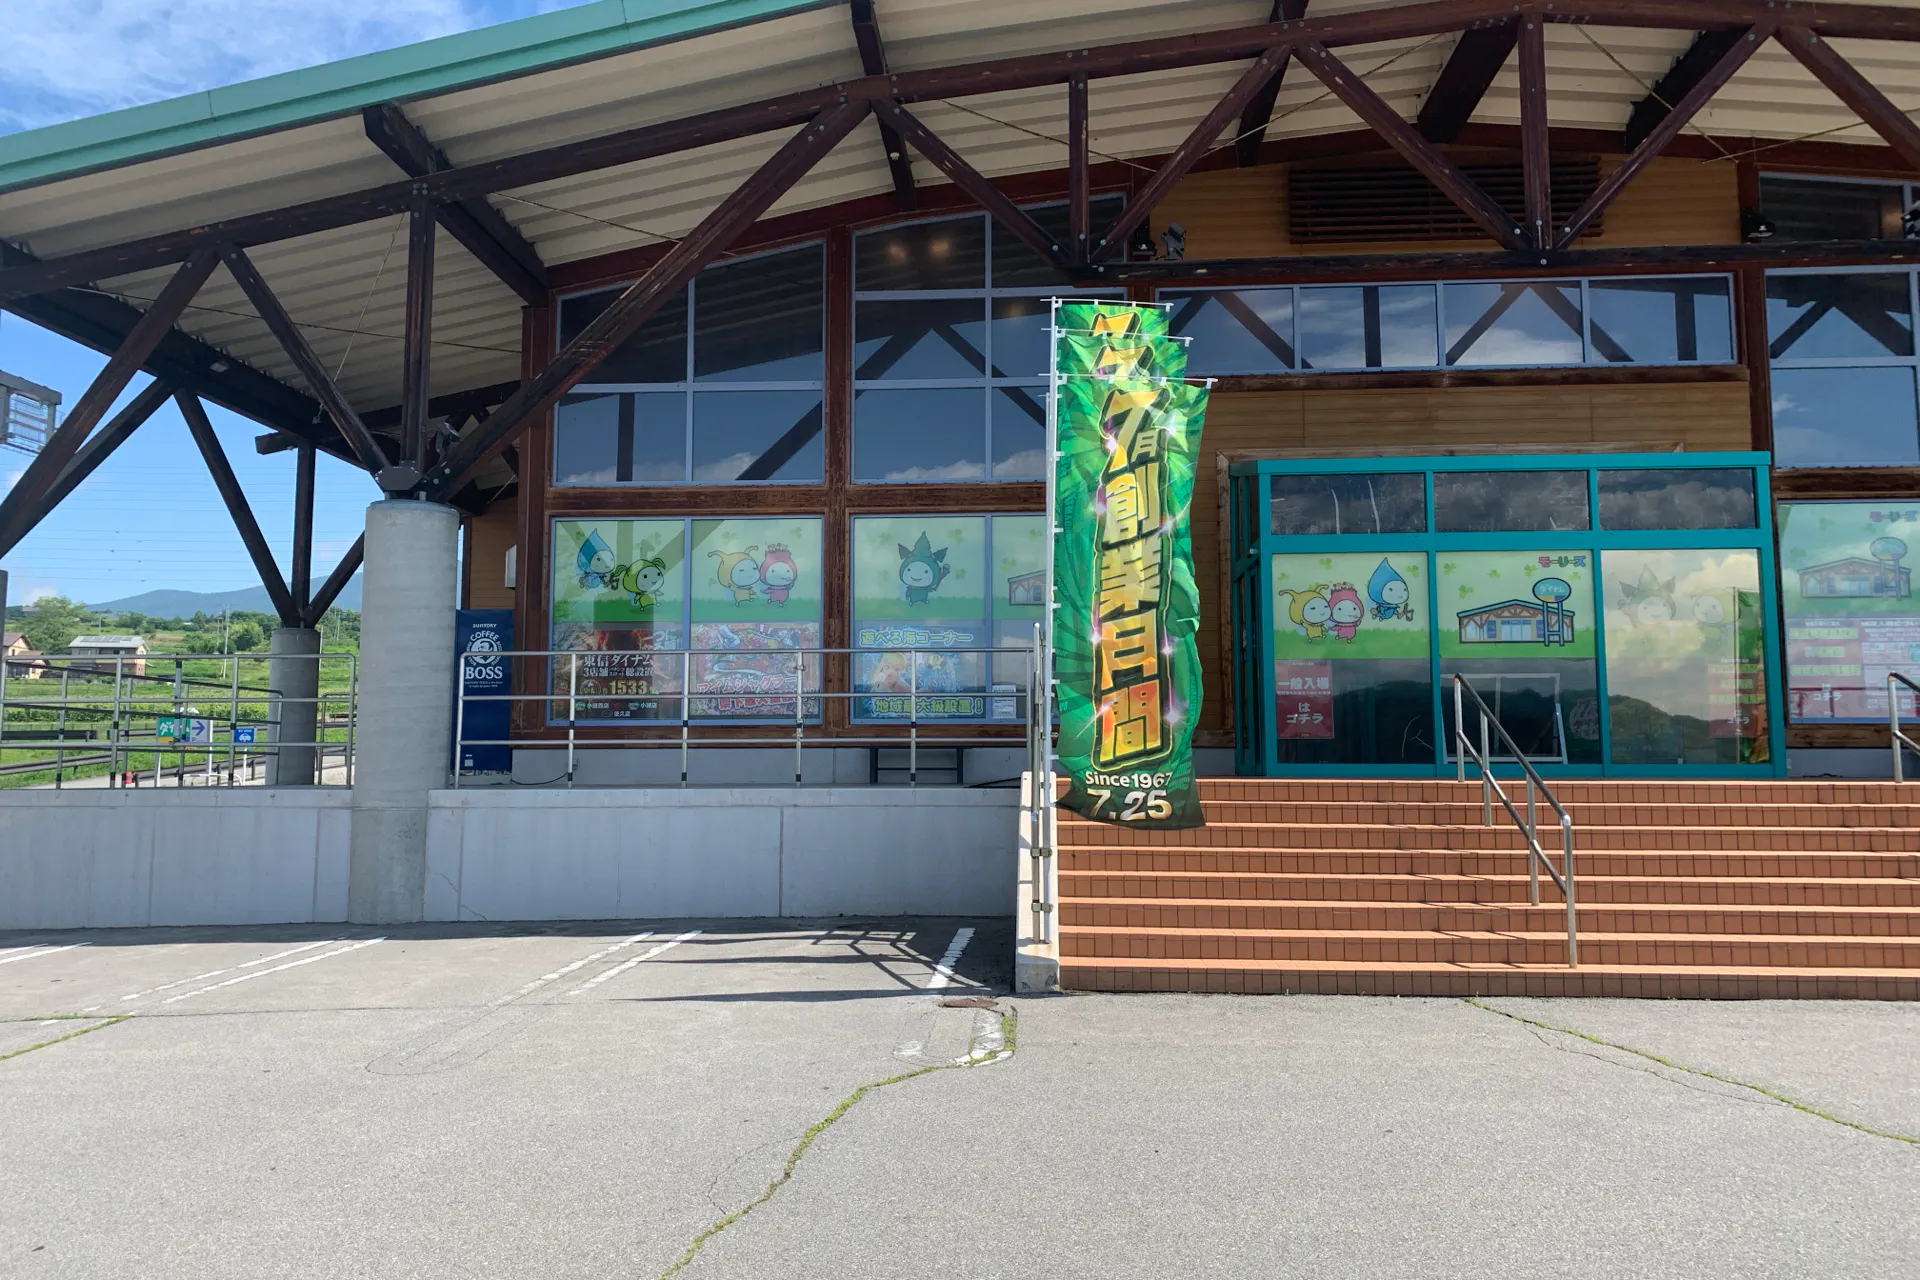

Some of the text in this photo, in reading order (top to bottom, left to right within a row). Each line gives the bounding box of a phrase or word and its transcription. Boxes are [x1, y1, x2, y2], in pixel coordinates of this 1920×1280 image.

[1538, 555, 1586, 568] モーリーズ
[470, 630, 500, 642] COFFEE
[859, 629, 974, 647] 遊べる海コーナー
[465, 666, 503, 680] BOSS
[1277, 677, 1330, 690] 一般入場
[1298, 702, 1311, 713] は
[1286, 712, 1324, 724] コチラ
[1086, 788, 1174, 821] 7.25
